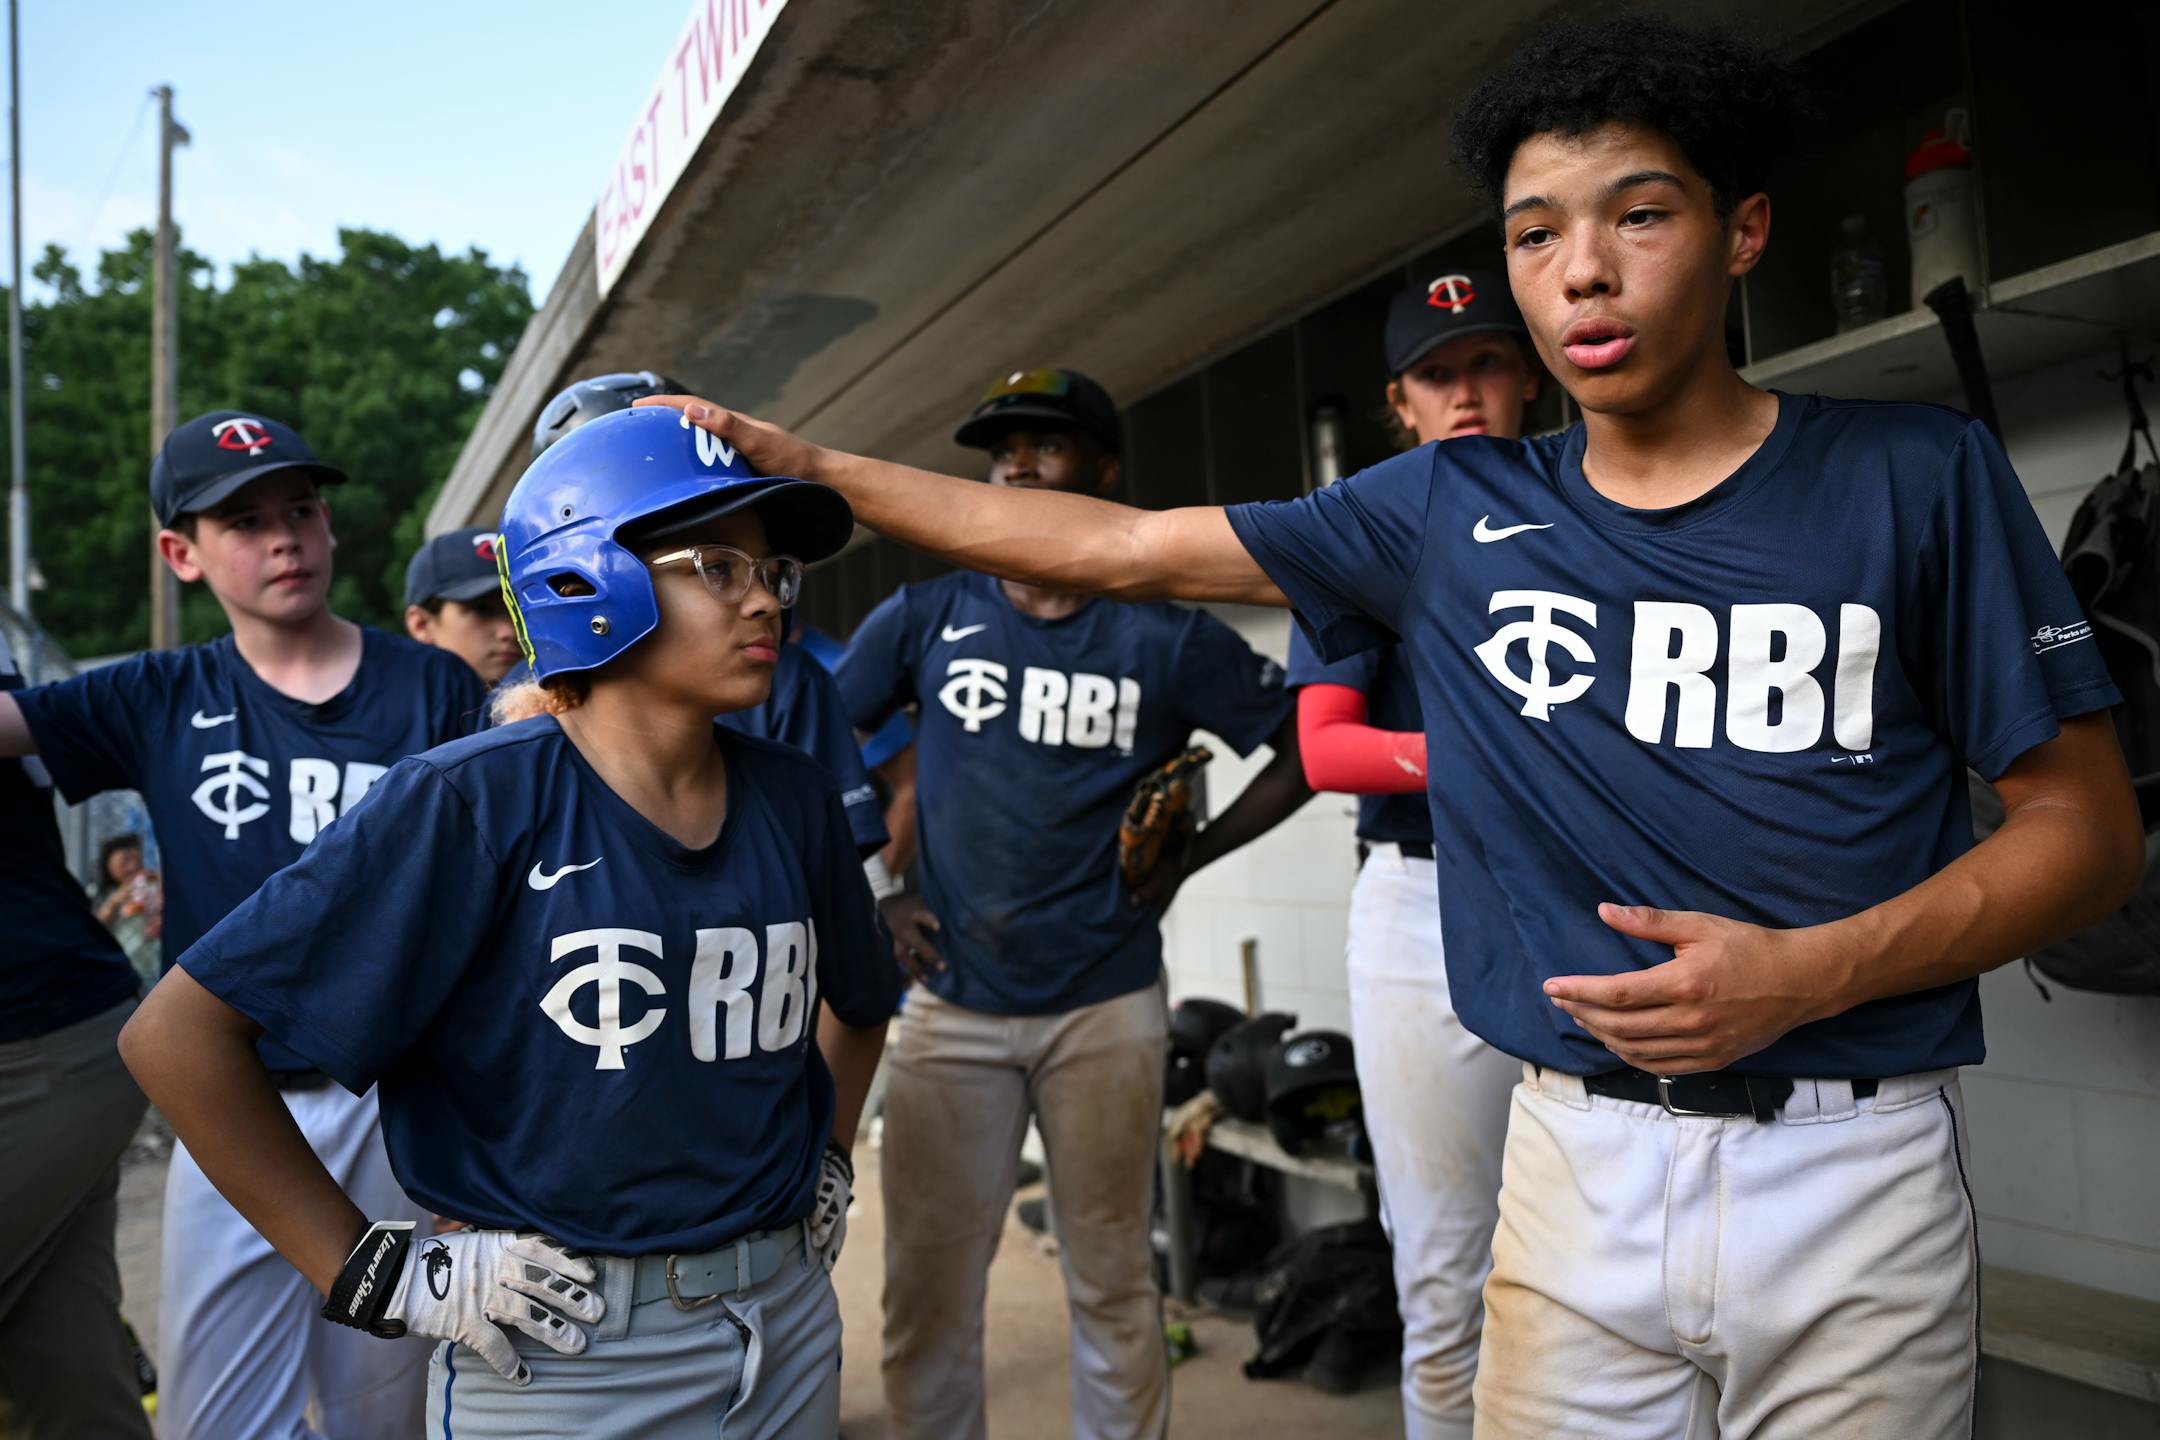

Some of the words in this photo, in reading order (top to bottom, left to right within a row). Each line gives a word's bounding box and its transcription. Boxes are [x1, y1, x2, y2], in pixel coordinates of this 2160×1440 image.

[602, 88, 663, 270] EAST
[1018, 666, 1141, 751] RBI
[1624, 600, 1881, 753] RBI
[348, 1274, 373, 1318] Skins
[366, 1231, 397, 1280] Lizard
